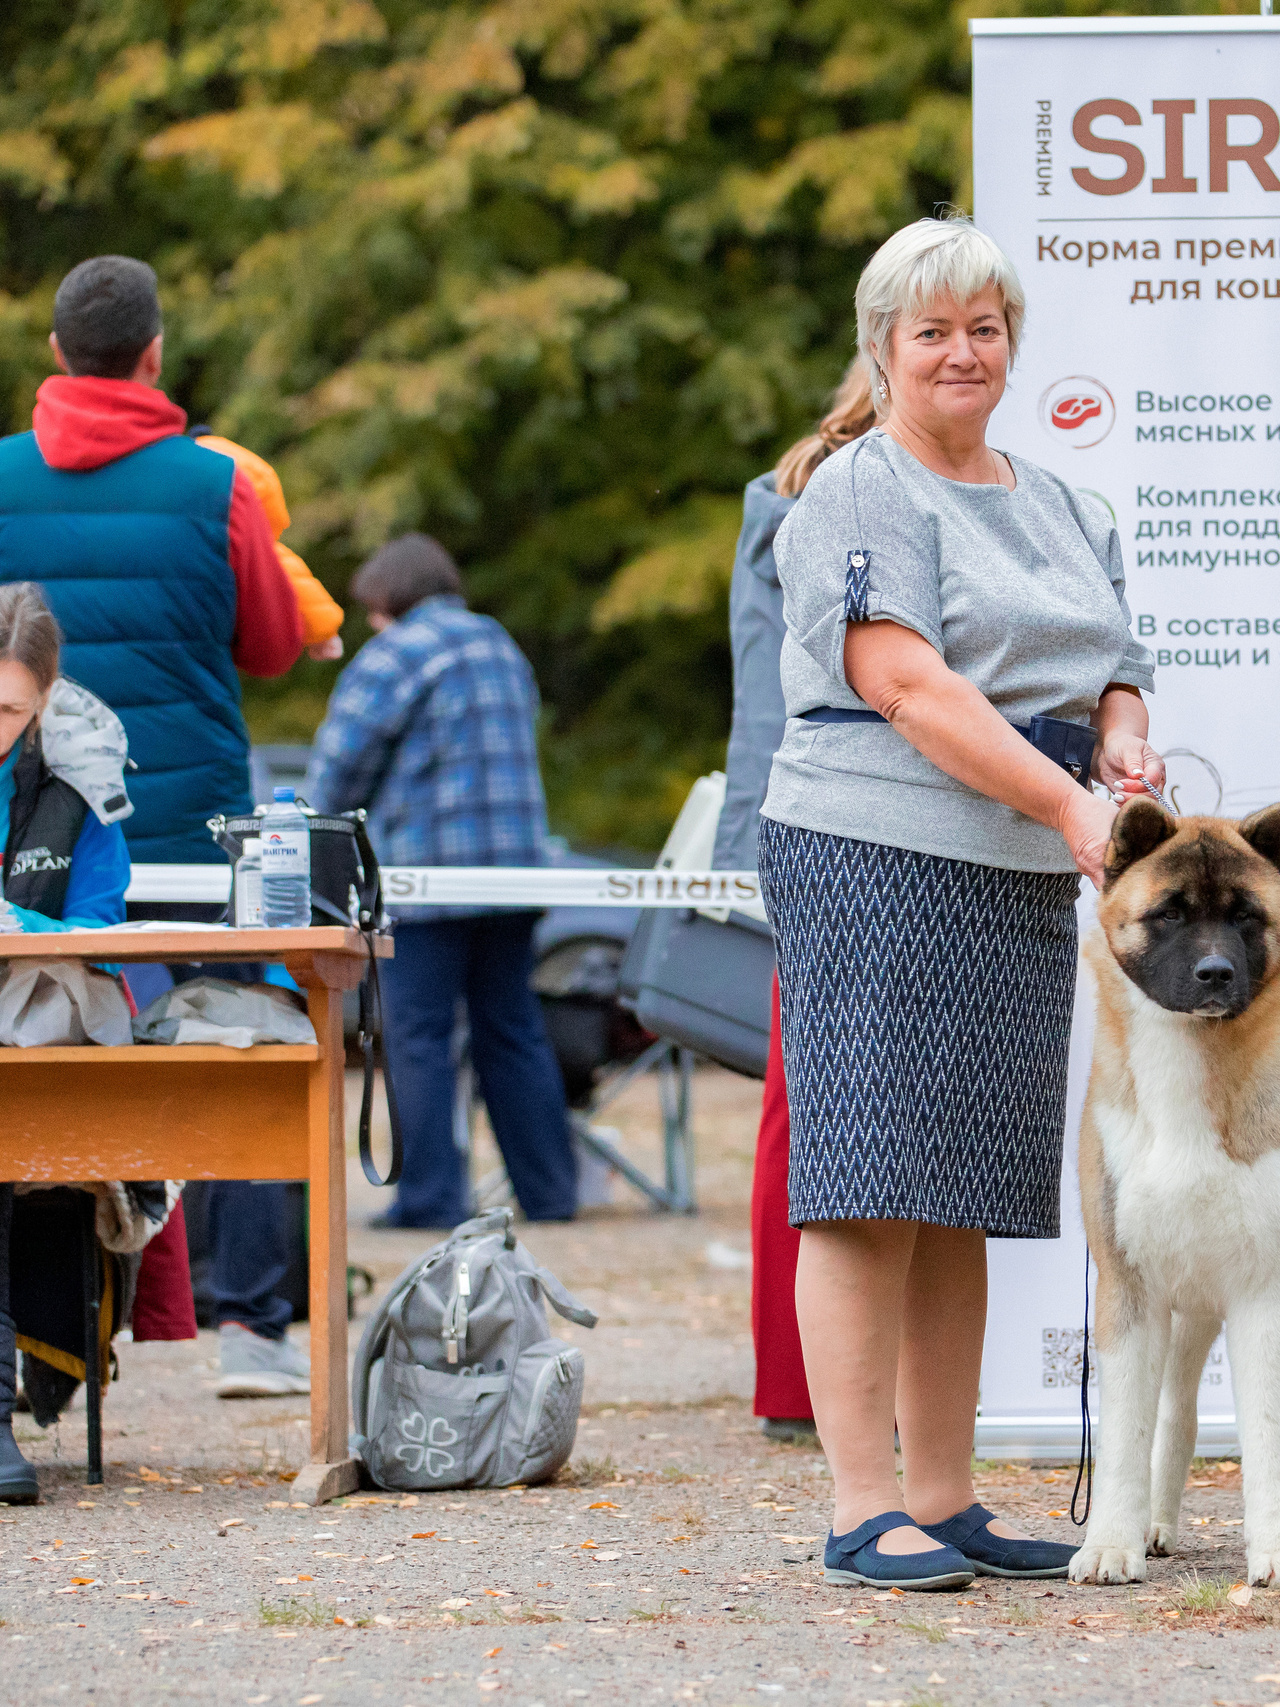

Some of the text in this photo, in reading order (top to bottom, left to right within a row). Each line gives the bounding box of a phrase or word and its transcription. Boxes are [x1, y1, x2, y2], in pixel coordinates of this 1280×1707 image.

[1036, 100, 1052, 196] PREMIUM
[1037, 235, 1160, 267] Корма
[1130, 278, 1201, 304] для
[1136, 390, 1272, 412] Высокое
[1135, 424, 1256, 443] мясных
[1135, 518, 1191, 541] для
[1138, 614, 1157, 636] В
[1150, 648, 1241, 669] вощи
[1252, 647, 1271, 665] и
